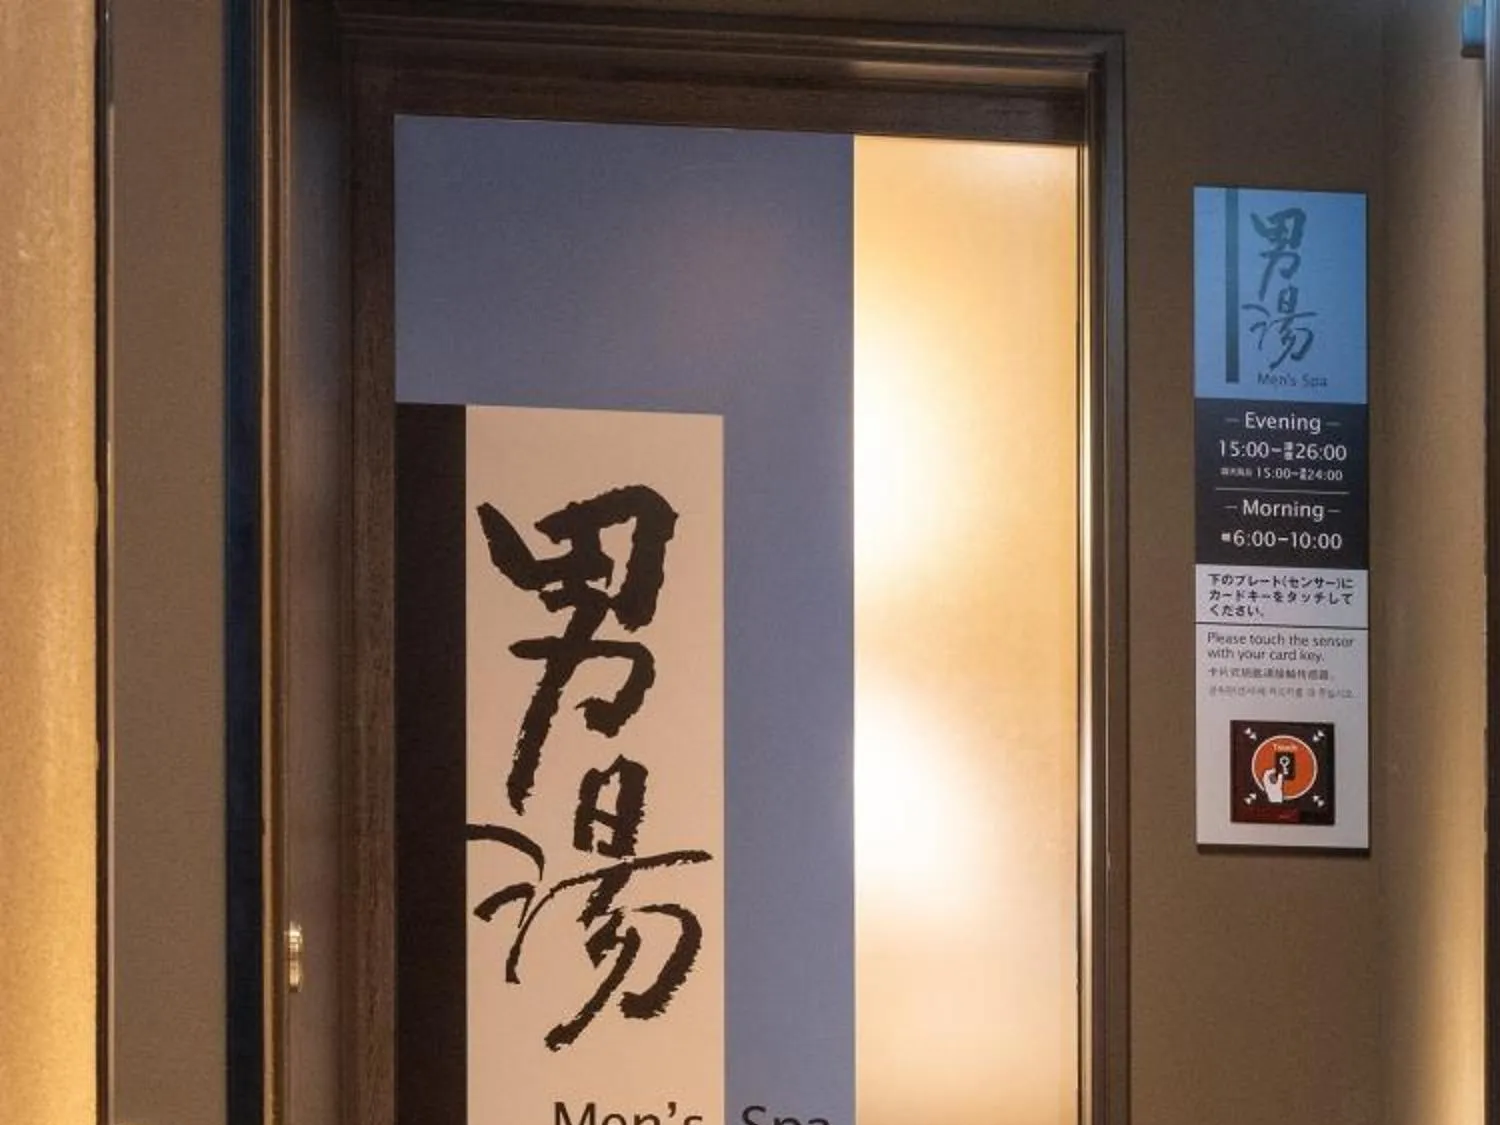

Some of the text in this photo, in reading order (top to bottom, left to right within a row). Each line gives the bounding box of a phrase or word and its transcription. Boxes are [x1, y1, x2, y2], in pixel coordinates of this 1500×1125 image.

[1241, 207, 1320, 371] 男湯
[1257, 373, 1297, 387] Men's
[1244, 411, 1322, 435] Evening
[1242, 498, 1325, 523] Morning
[1207, 632, 1354, 648] Please touch the sensor
[1207, 647, 1235, 660] with
[1238, 651, 1266, 664] your
[1268, 648, 1297, 662] card
[466, 484, 712, 1052] 男湯
